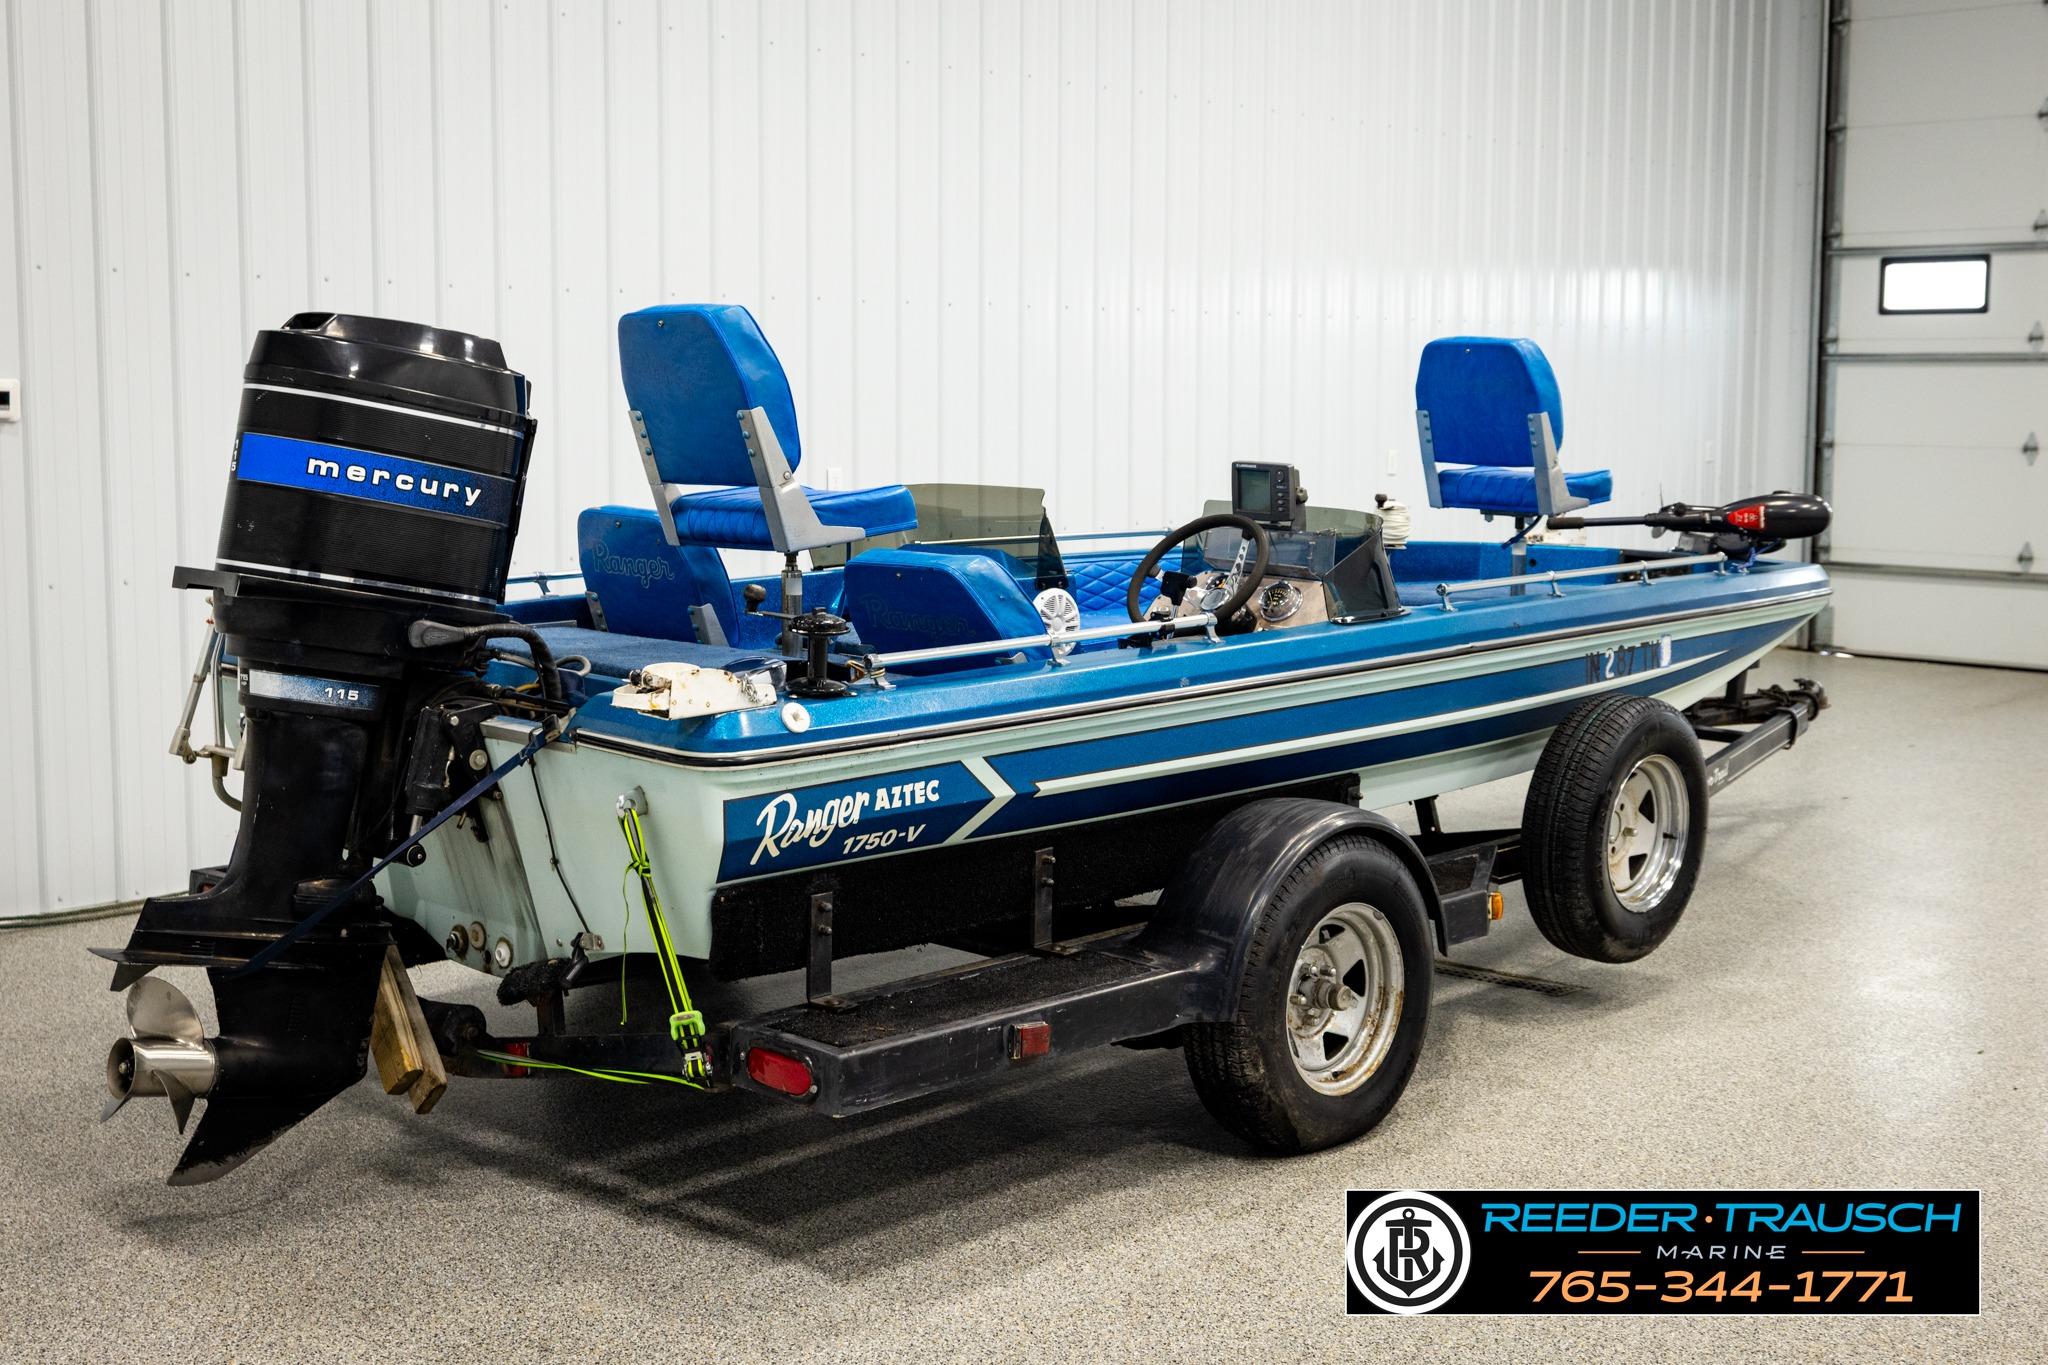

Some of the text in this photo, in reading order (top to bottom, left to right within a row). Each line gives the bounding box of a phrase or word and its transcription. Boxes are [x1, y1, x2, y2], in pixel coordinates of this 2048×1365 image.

[307, 458, 481, 506] mercury
[592, 540, 675, 589] Ranger
[325, 687, 359, 701] 115
[750, 779, 940, 865] Ranger AZTEC
[842, 824, 926, 855] 1750-V
